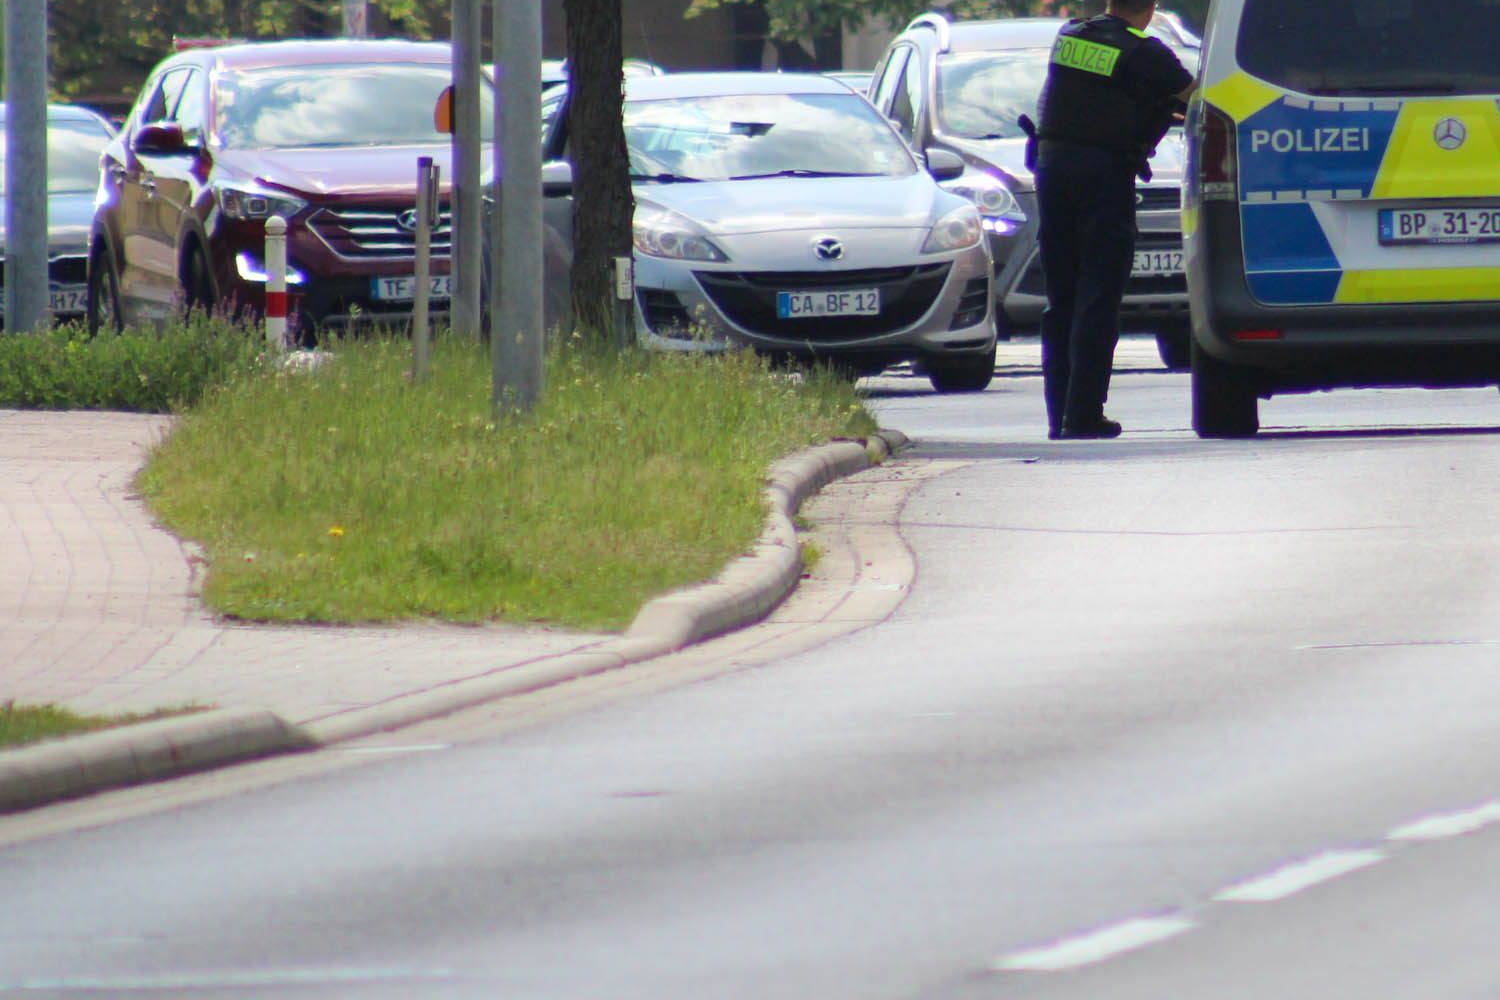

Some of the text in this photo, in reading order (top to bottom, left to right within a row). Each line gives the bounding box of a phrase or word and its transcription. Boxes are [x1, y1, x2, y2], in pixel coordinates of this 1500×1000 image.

[1054, 36, 1116, 74] POLIZEI
[1251, 127, 1369, 153] POLIZEI
[1399, 212, 1426, 236] BP
[384, 278, 408, 297] TF
[789, 292, 877, 313] CA BF 12
